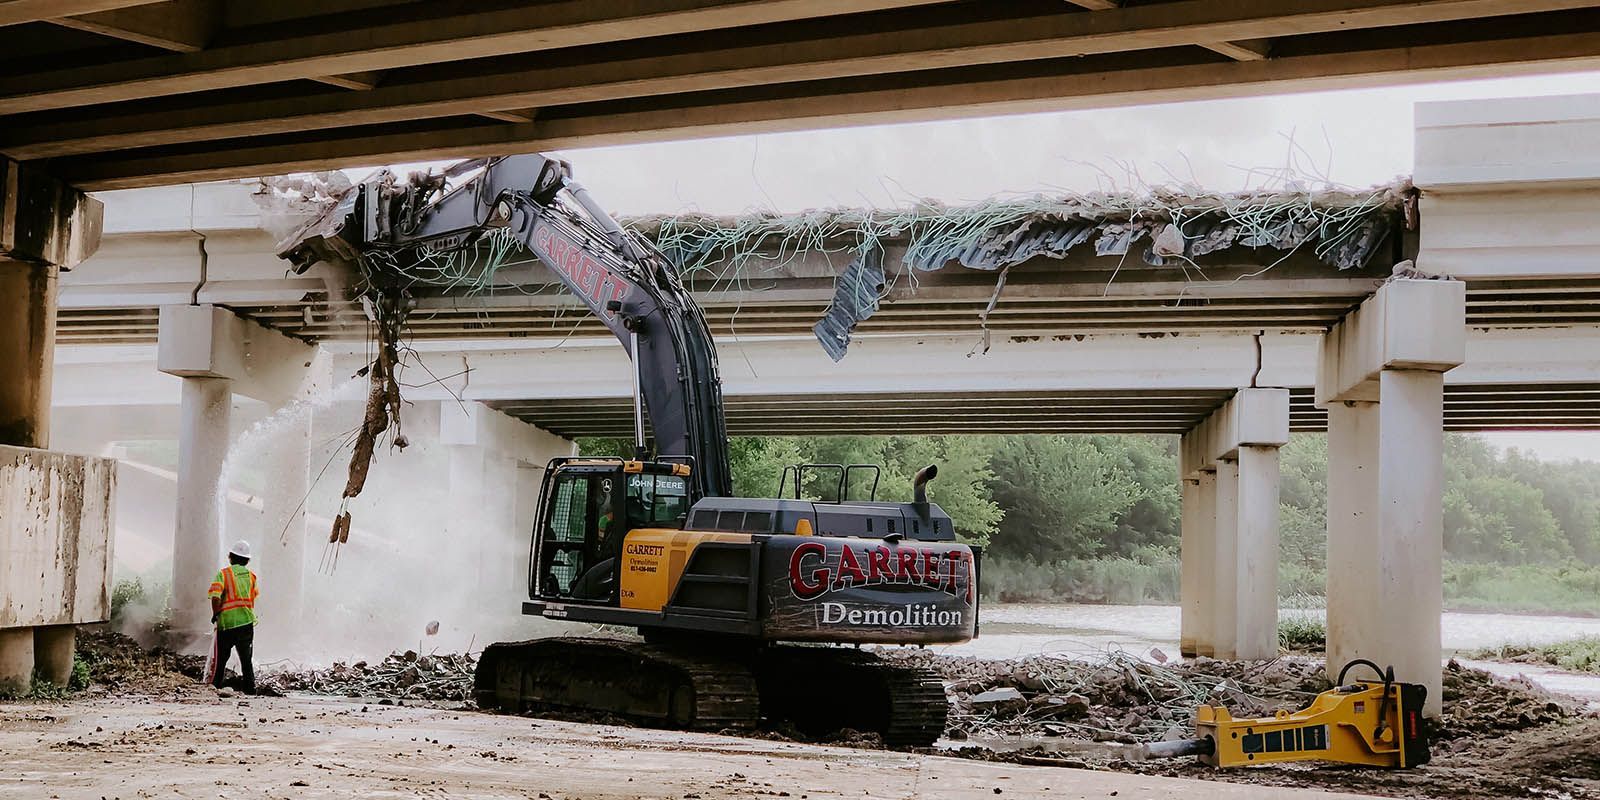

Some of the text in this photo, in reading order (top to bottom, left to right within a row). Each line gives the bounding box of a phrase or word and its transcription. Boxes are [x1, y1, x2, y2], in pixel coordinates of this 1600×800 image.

[536, 226, 631, 321] GARRETT
[629, 476, 683, 489] JOHN DEERE
[626, 544, 665, 556] GARRETT
[820, 602, 962, 627] Demolition
